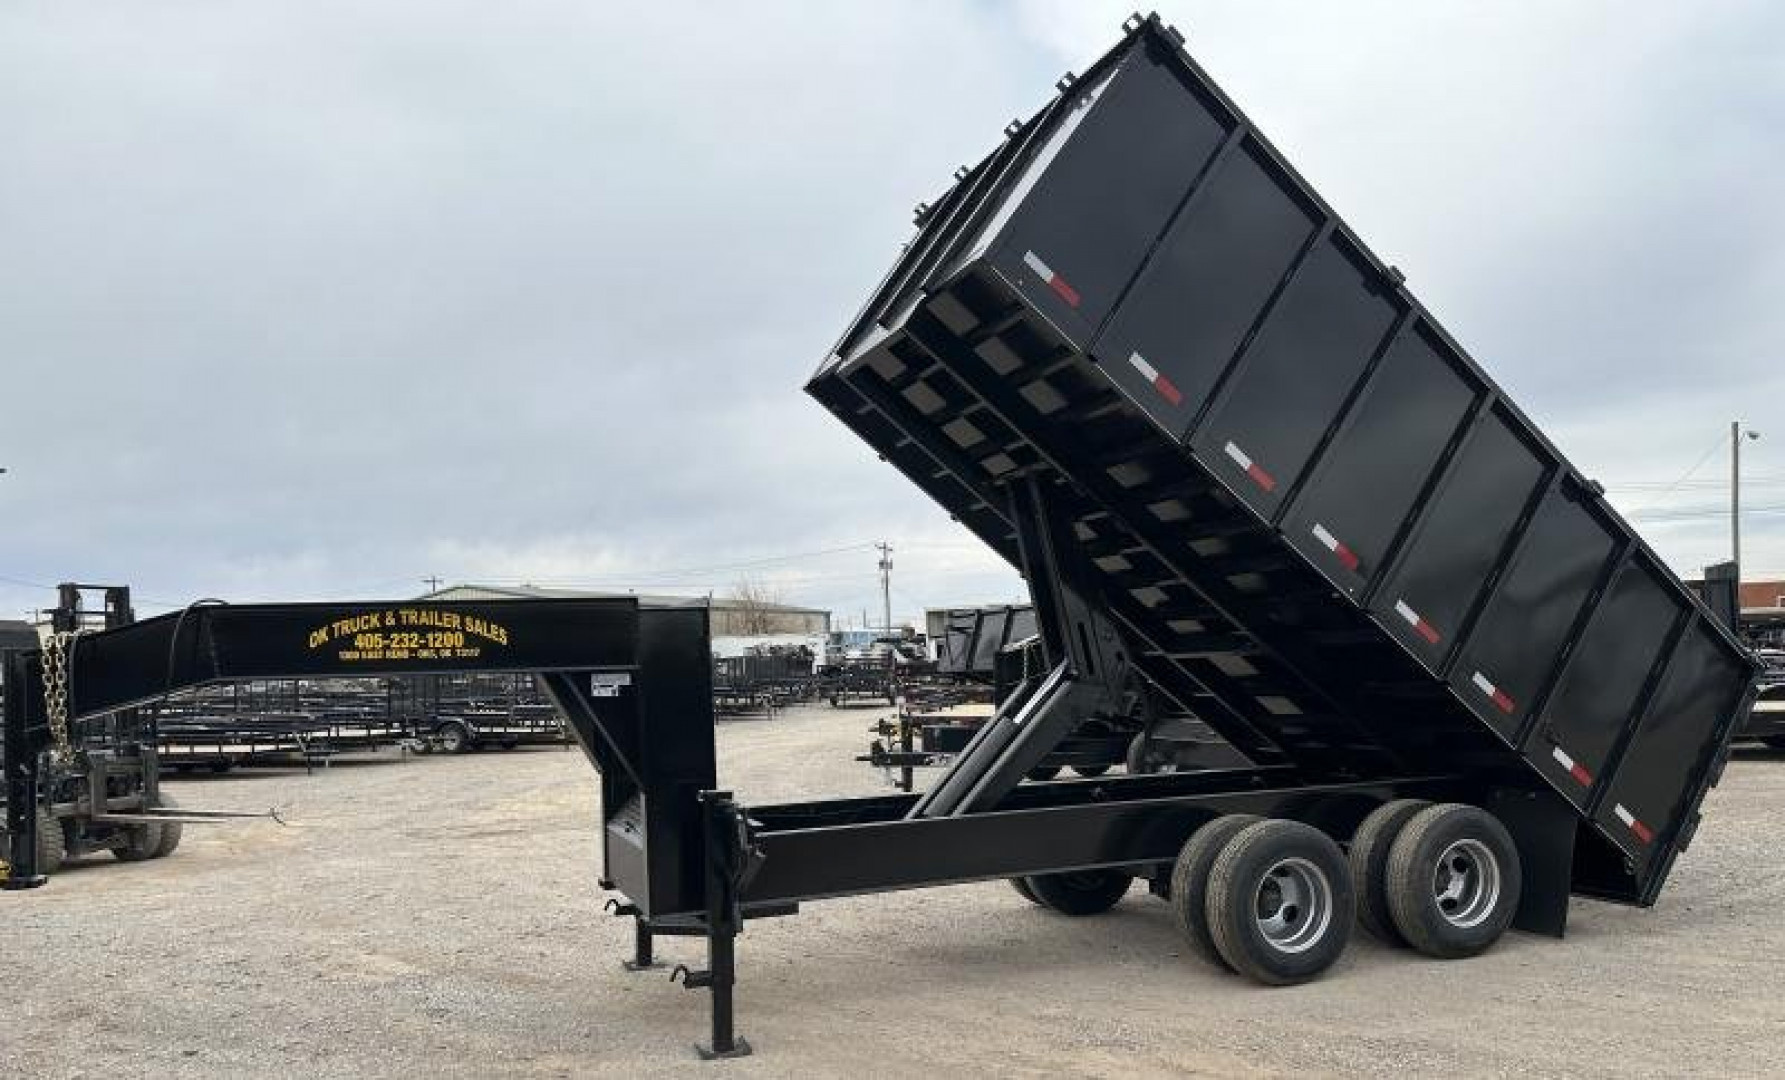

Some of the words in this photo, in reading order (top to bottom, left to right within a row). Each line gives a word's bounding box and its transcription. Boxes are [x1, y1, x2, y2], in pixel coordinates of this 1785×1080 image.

[332, 613, 380, 638] TRUCK
[385, 611, 396, 626] &
[399, 610, 462, 630] TRAILER
[464, 616, 507, 645] SALES
